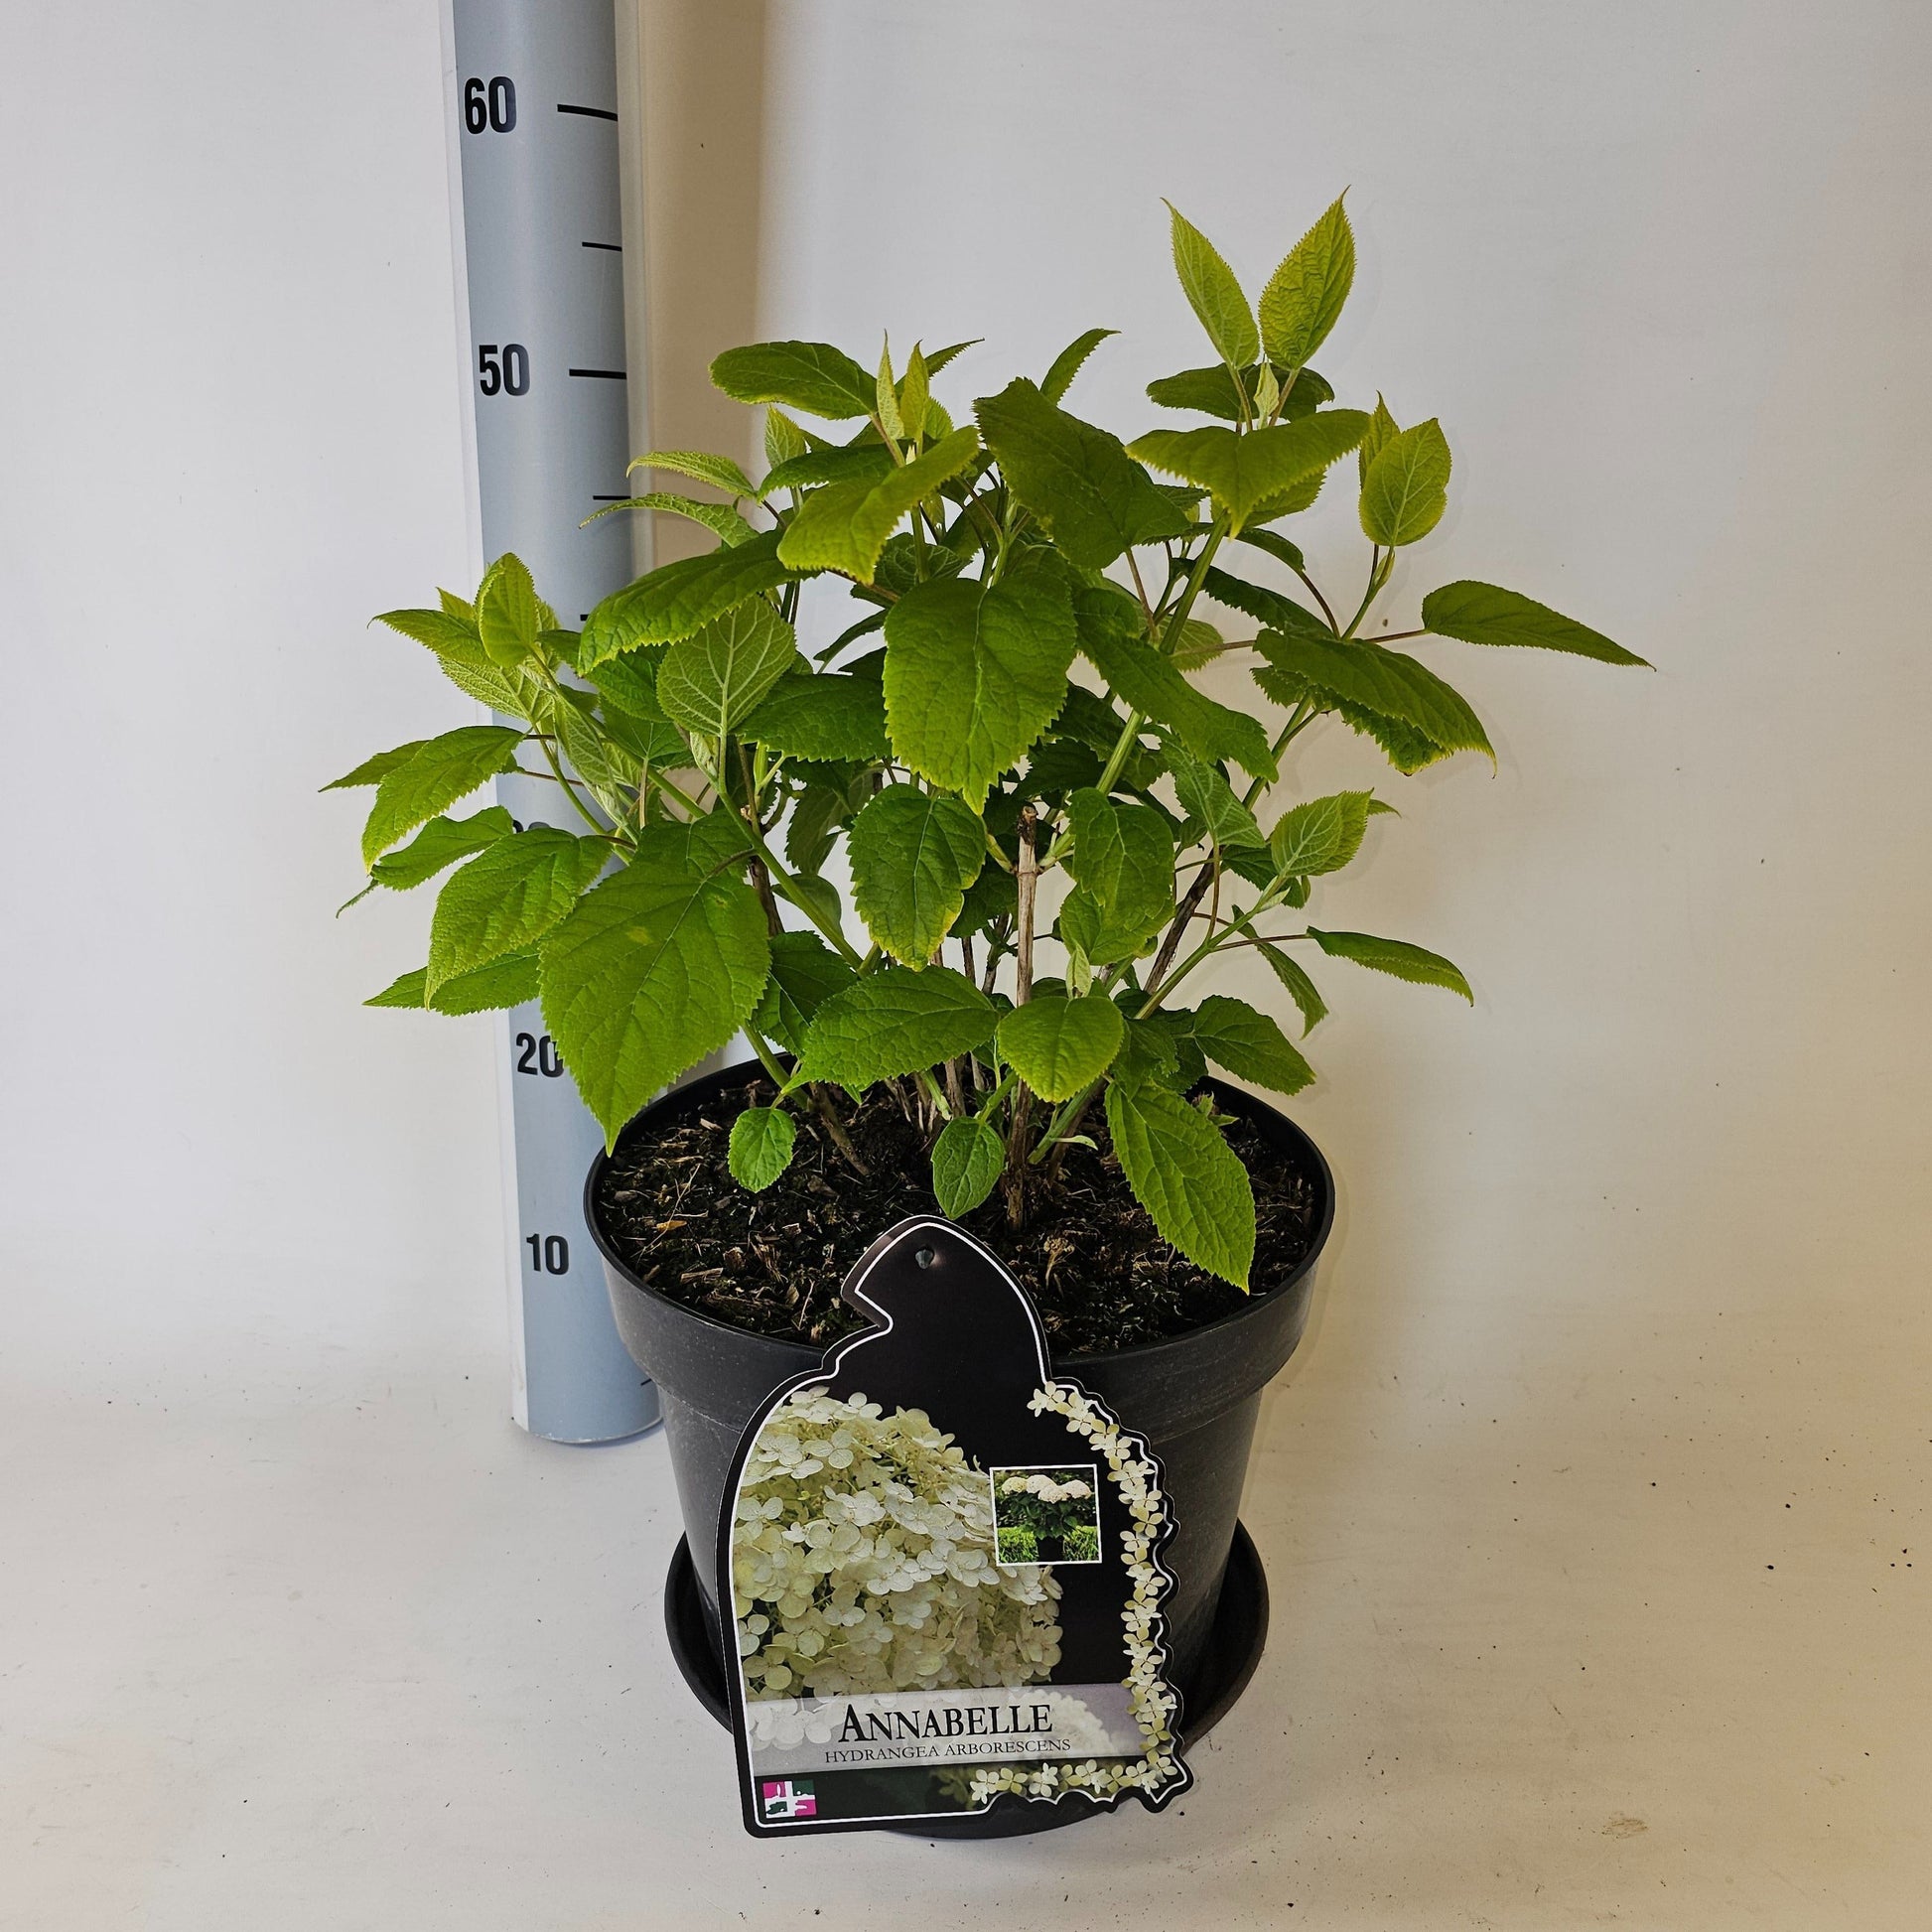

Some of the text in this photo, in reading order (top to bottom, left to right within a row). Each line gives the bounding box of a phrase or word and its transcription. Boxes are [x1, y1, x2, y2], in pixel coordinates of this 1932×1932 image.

[465, 76, 516, 134] 60
[479, 344, 530, 396] 50
[516, 1033, 564, 1077] 20
[526, 1233, 569, 1275] 10
[839, 1704, 1053, 1742] ANNABELLE
[825, 1739, 1071, 1764] HYDRANGEA ARBORESCENS
